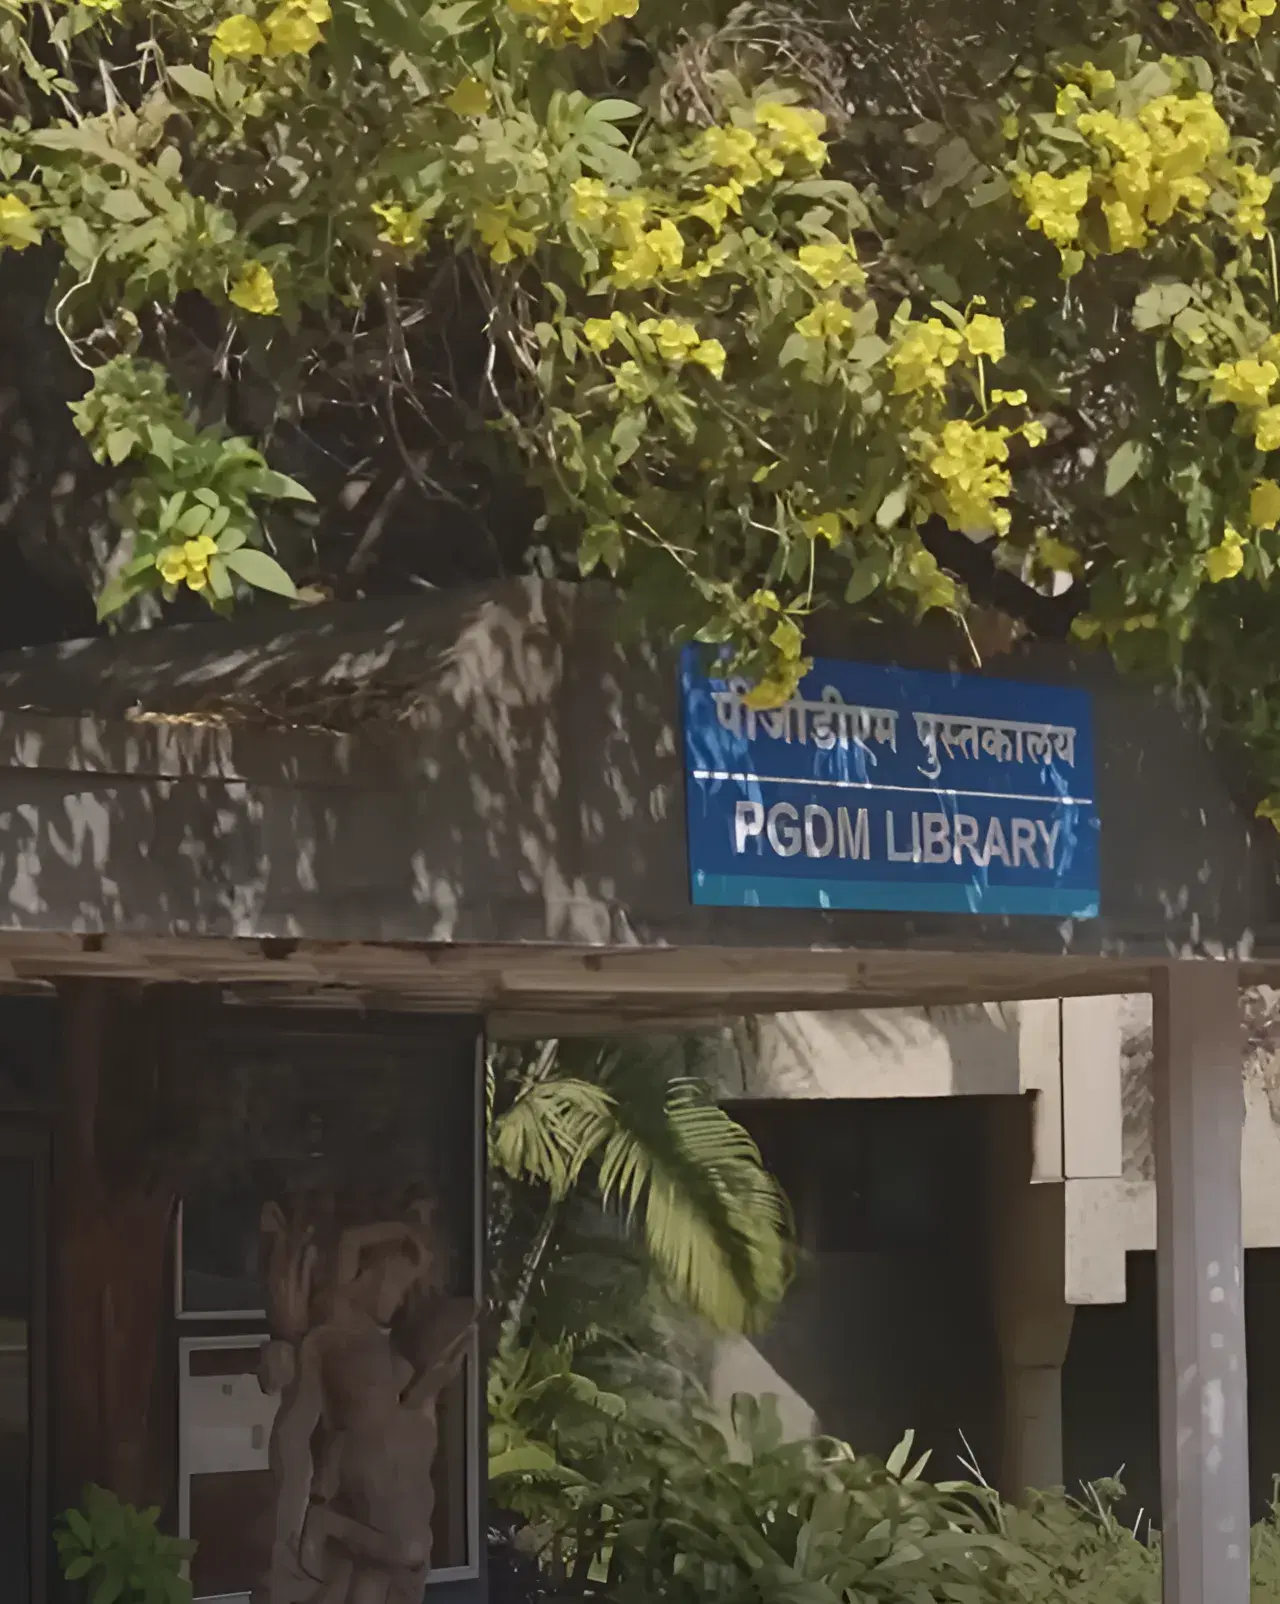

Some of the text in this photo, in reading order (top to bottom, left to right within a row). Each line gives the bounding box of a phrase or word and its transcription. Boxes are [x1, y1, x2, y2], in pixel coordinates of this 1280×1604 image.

[912, 711, 1077, 779] पुस्तकालय
[734, 801, 1062, 870] PGDM LIBRARY
